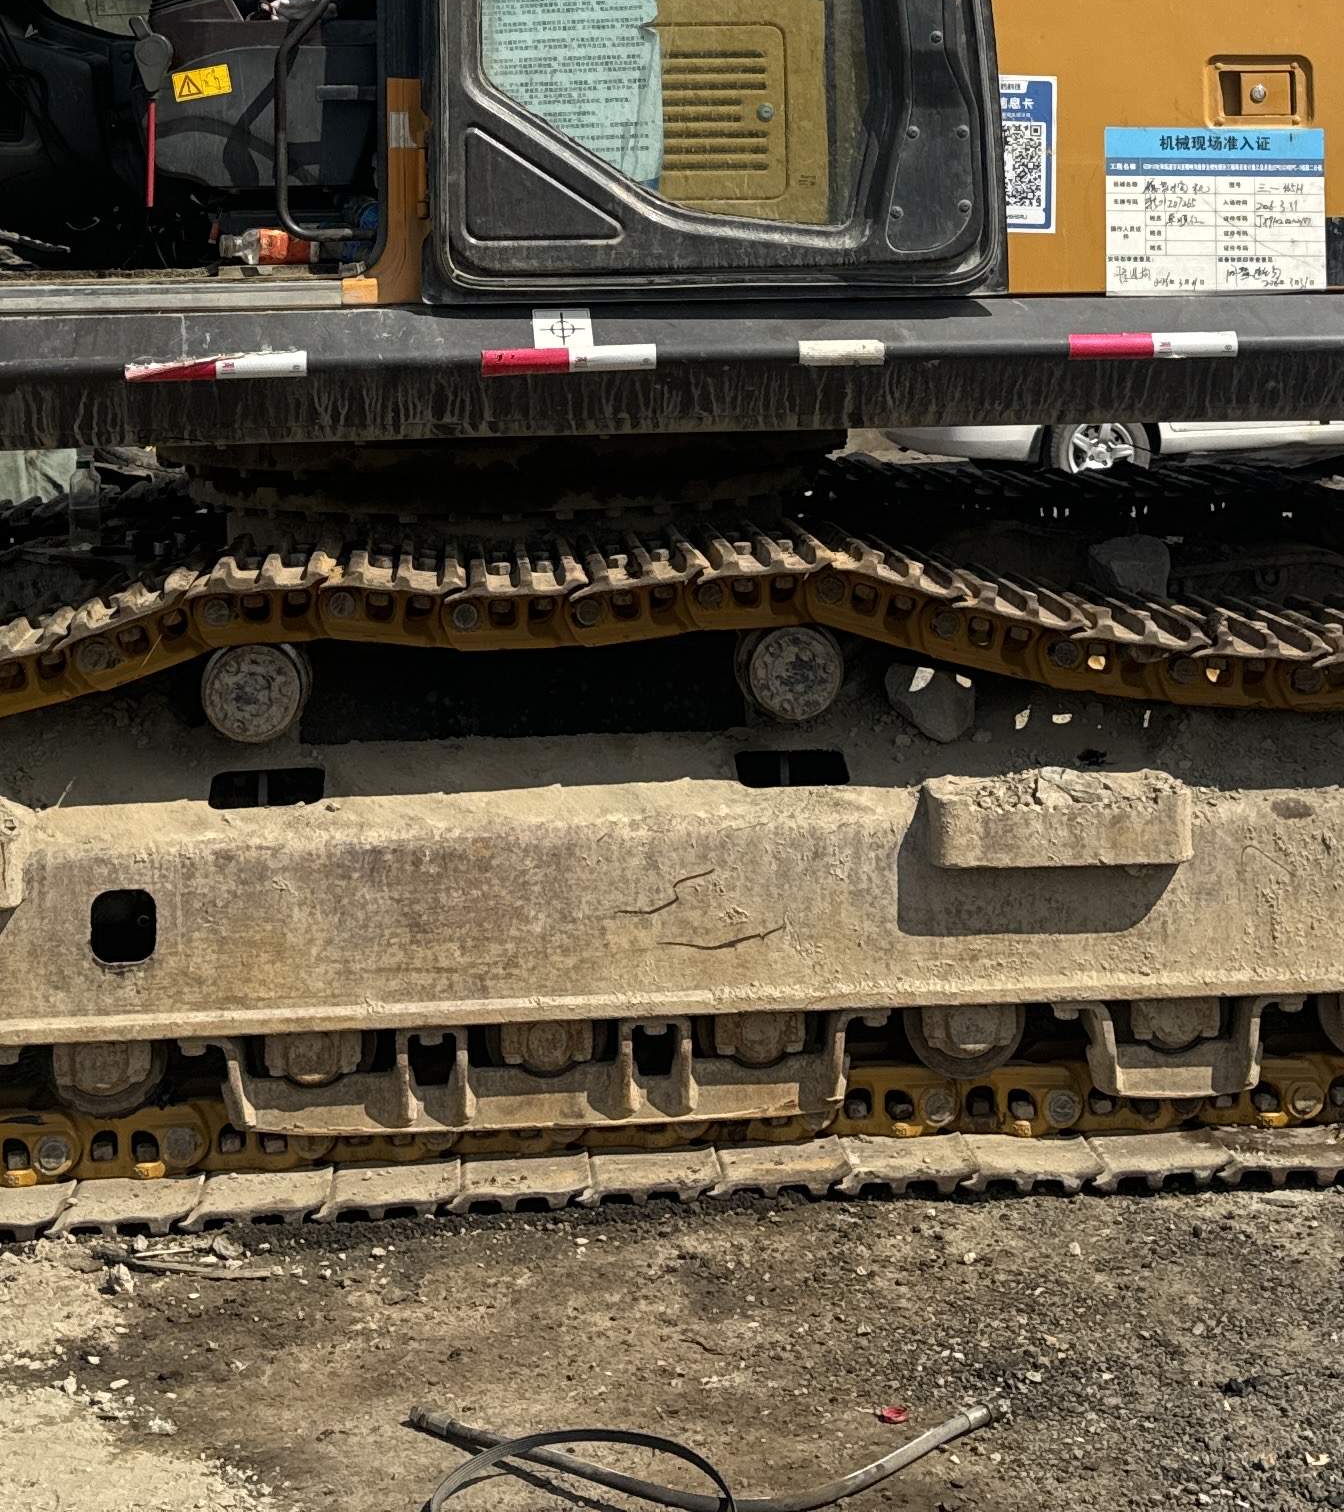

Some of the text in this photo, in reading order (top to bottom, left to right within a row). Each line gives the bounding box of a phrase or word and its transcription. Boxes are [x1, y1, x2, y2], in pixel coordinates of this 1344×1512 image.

[1159, 135, 1272, 152] 机械现场准入证
